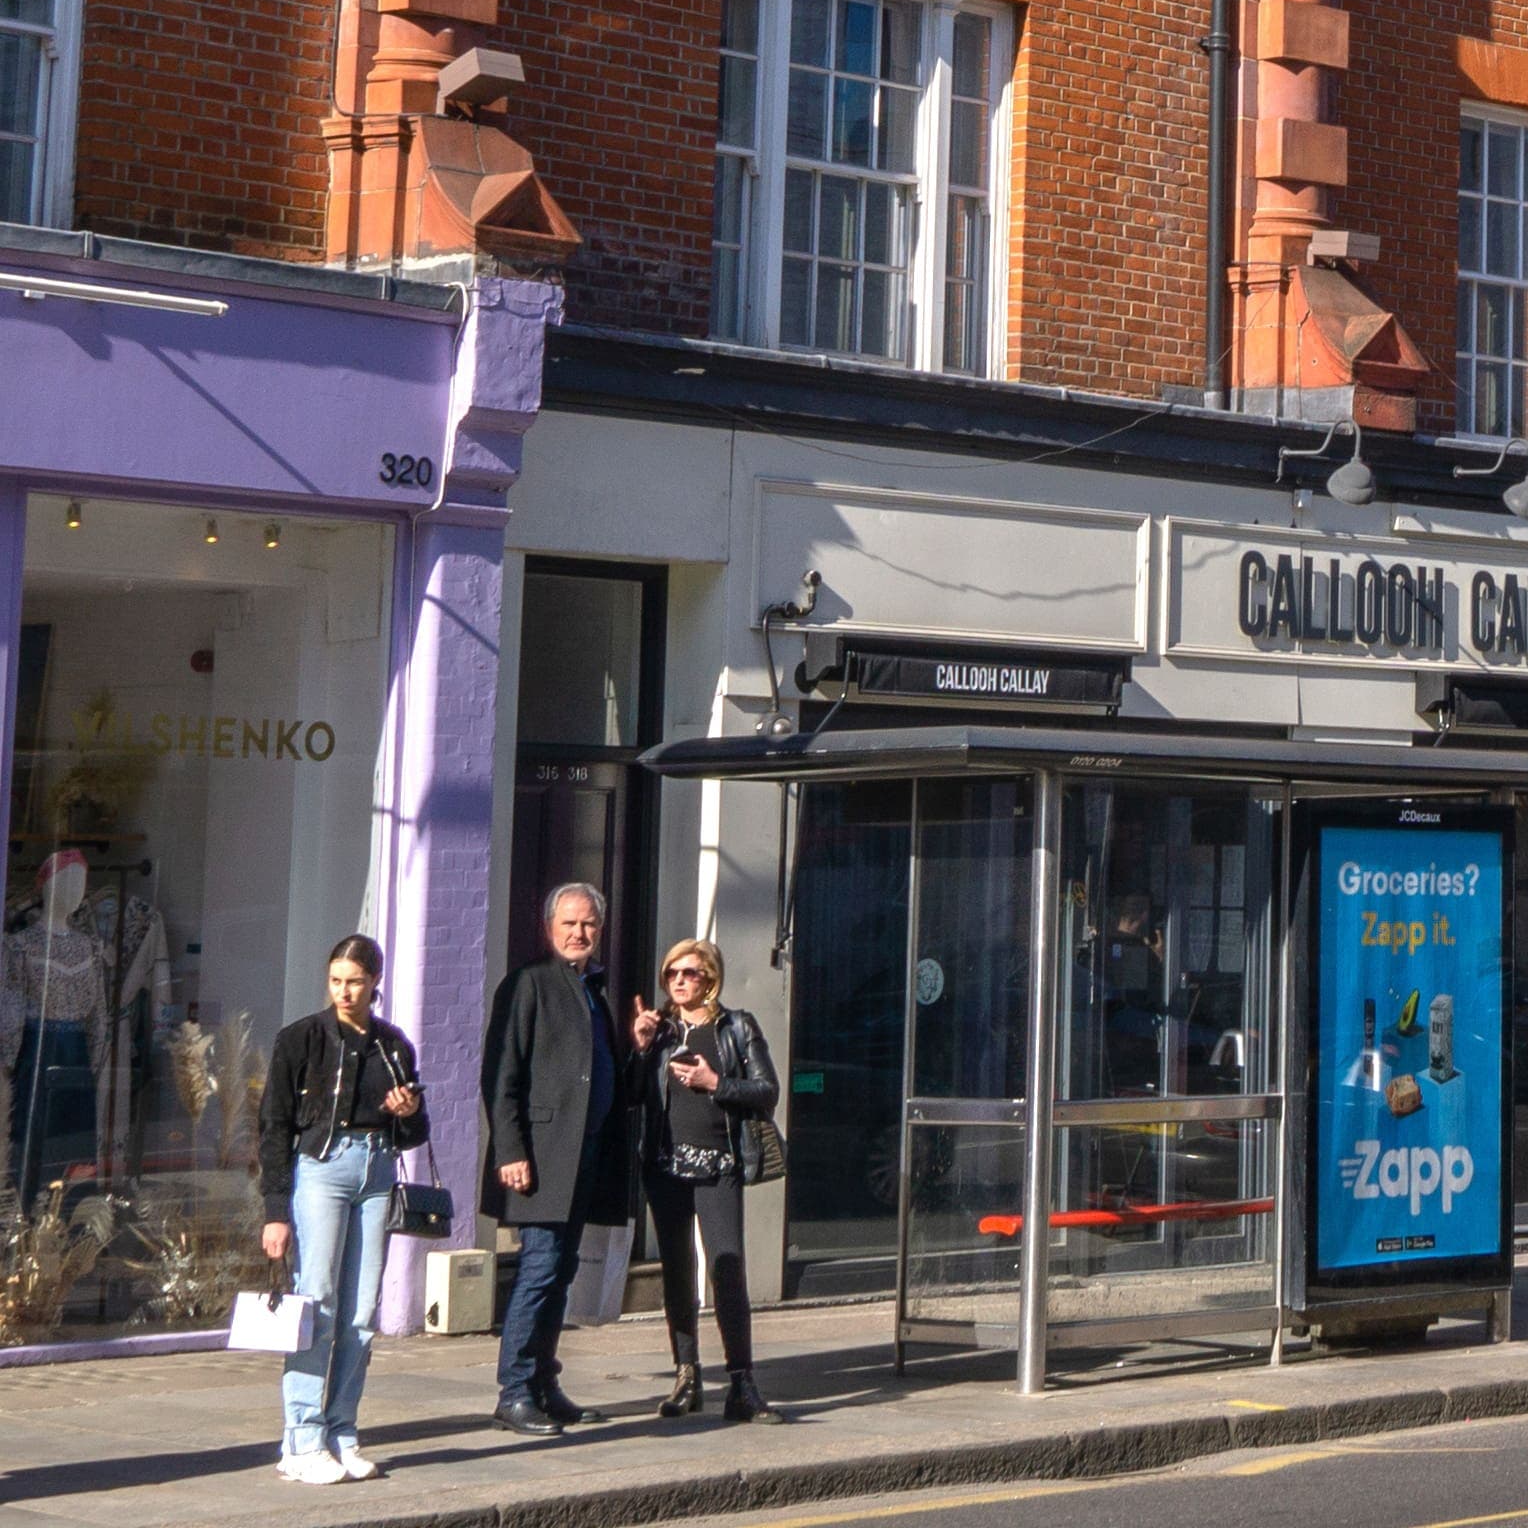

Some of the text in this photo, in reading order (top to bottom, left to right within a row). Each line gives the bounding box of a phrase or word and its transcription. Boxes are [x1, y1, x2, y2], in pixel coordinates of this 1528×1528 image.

[378, 451, 433, 487] 320
[1238, 550, 1445, 650] CALLOOH
[936, 664, 1051, 695] CALLOOH CALLAY
[70, 711, 336, 762] VILSHENKO
[1398, 809, 1441, 823] JCDecaux
[1337, 860, 1481, 897] Groceries?
[1360, 911, 1457, 956] Zapp it.
[1353, 1139, 1474, 1216] Zapp
